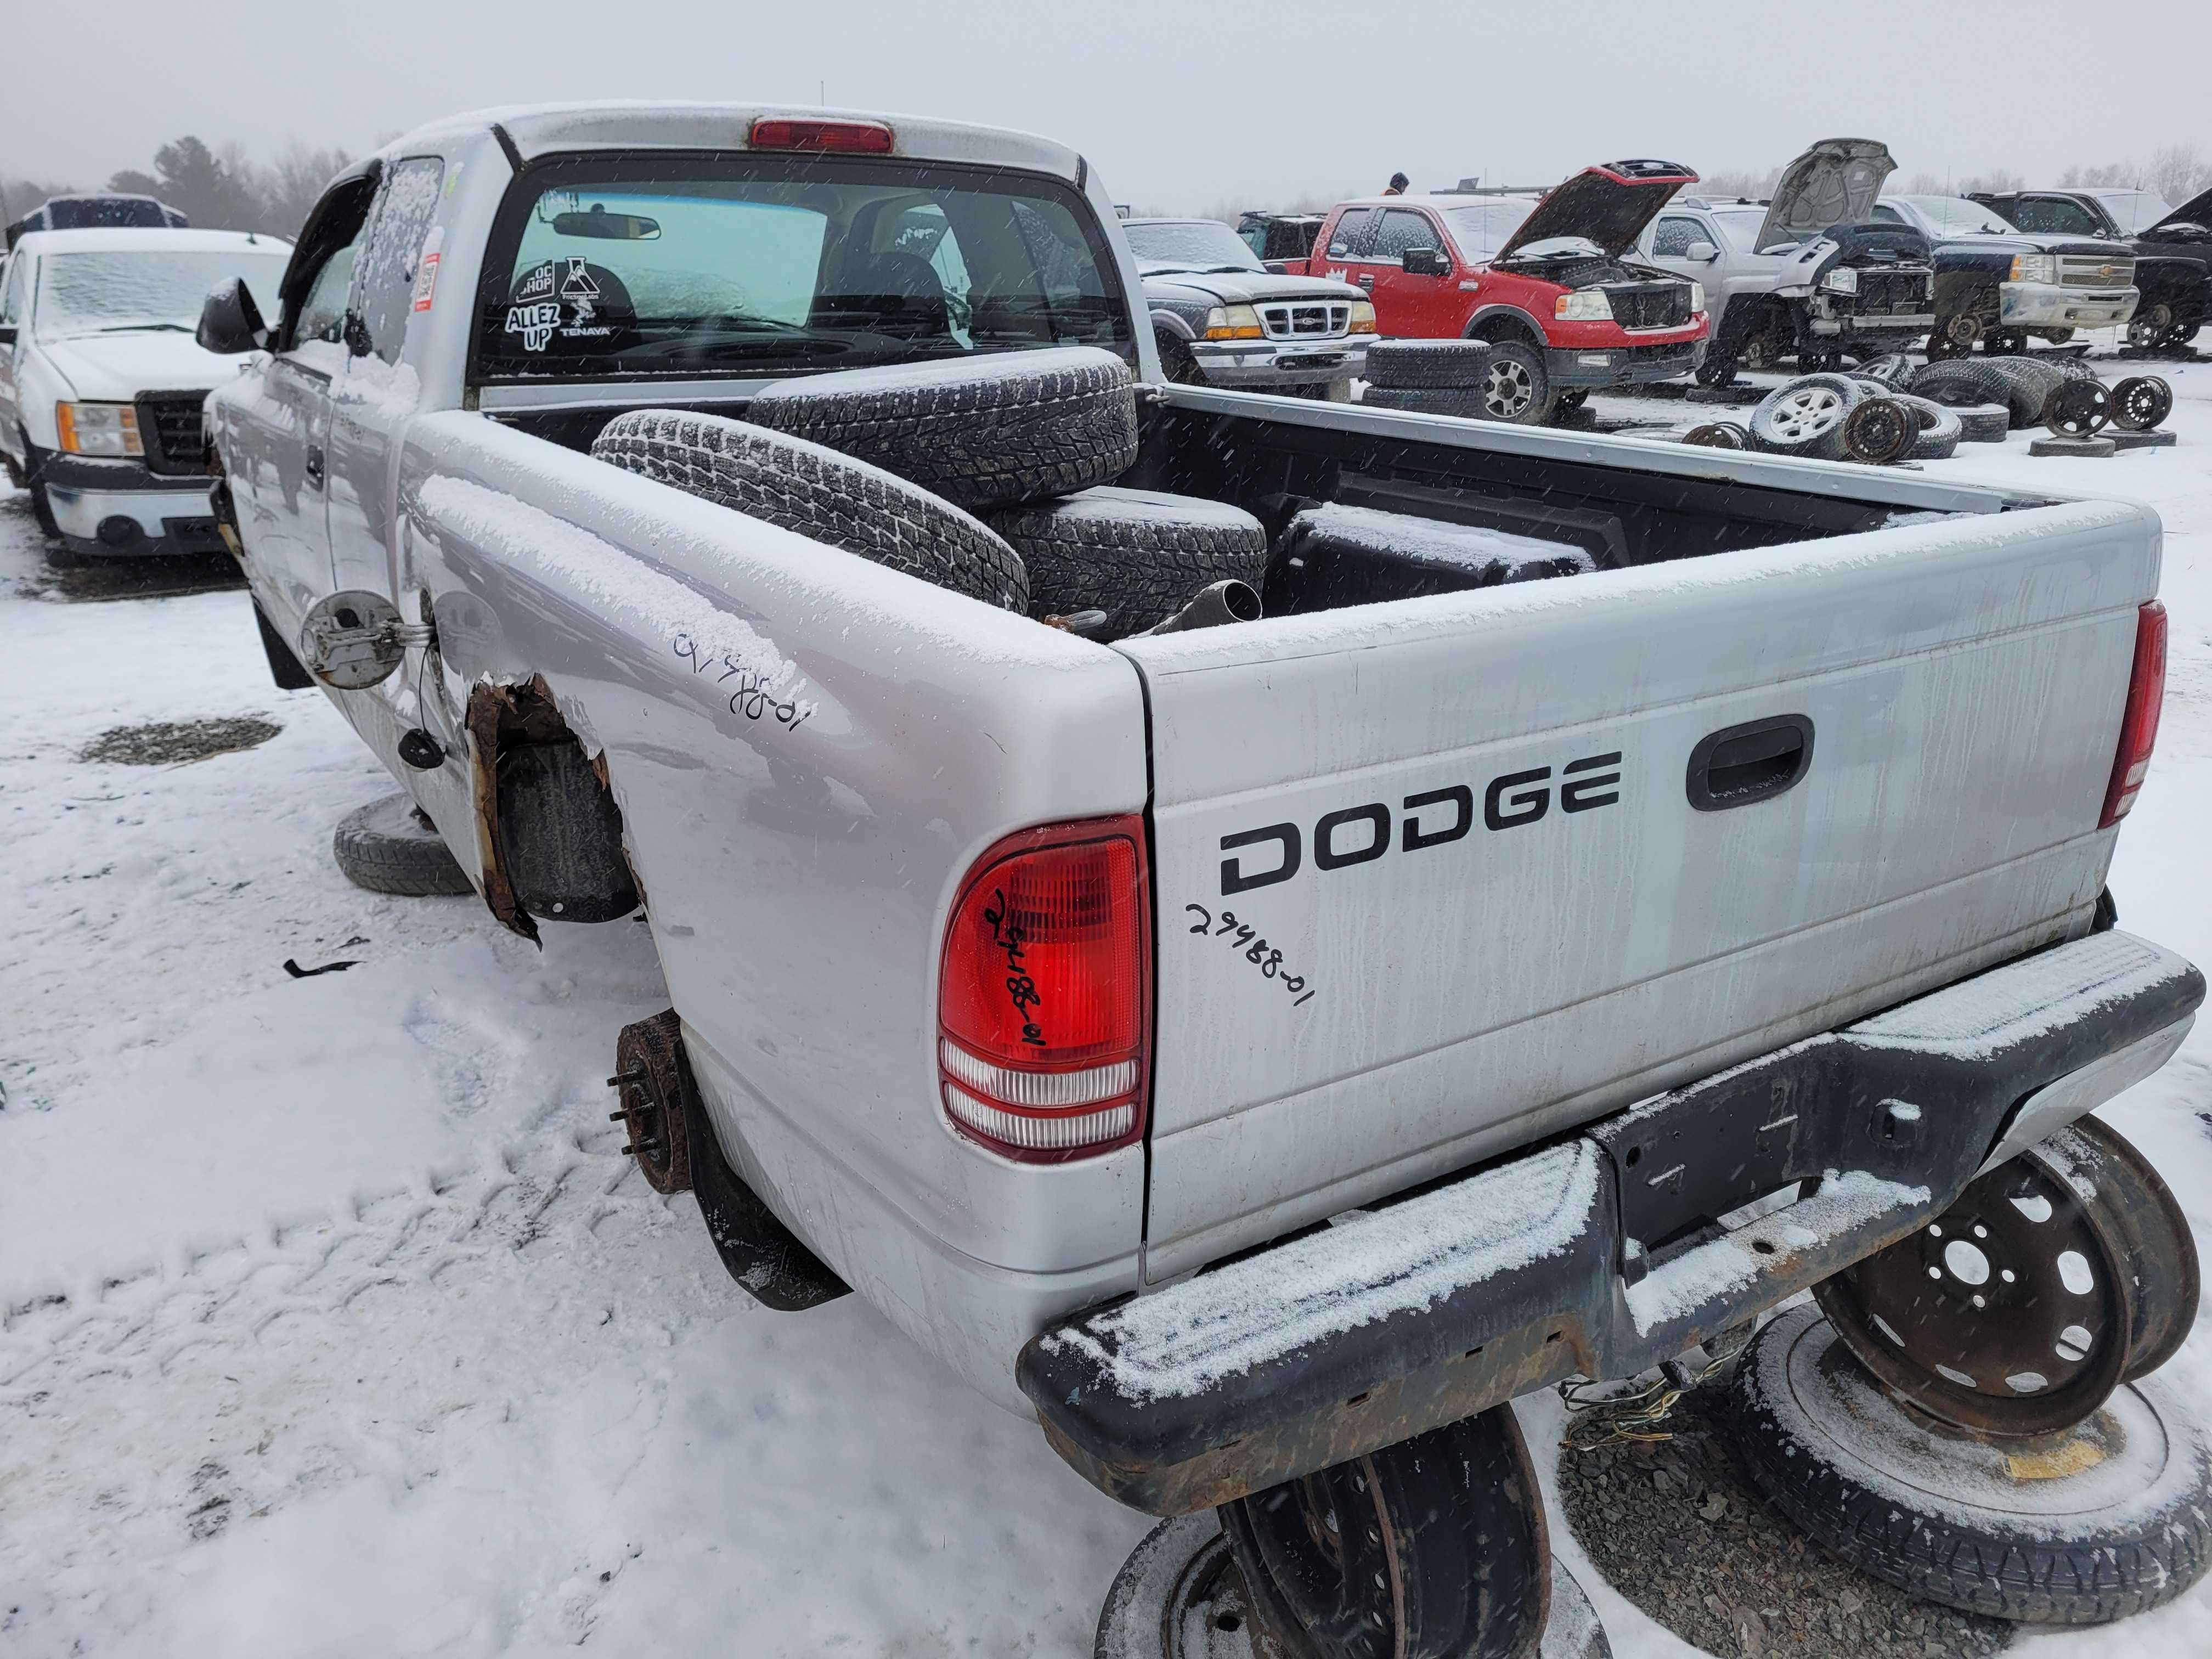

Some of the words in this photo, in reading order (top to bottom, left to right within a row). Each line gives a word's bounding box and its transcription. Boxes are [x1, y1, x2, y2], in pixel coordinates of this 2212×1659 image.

[508, 305, 558, 331] ALLEZ
[527, 328, 549, 349] UP
[560, 328, 610, 336] TENAYA
[1221, 751, 1622, 896] DODGE
[1185, 903, 1316, 1007] 29488-01
